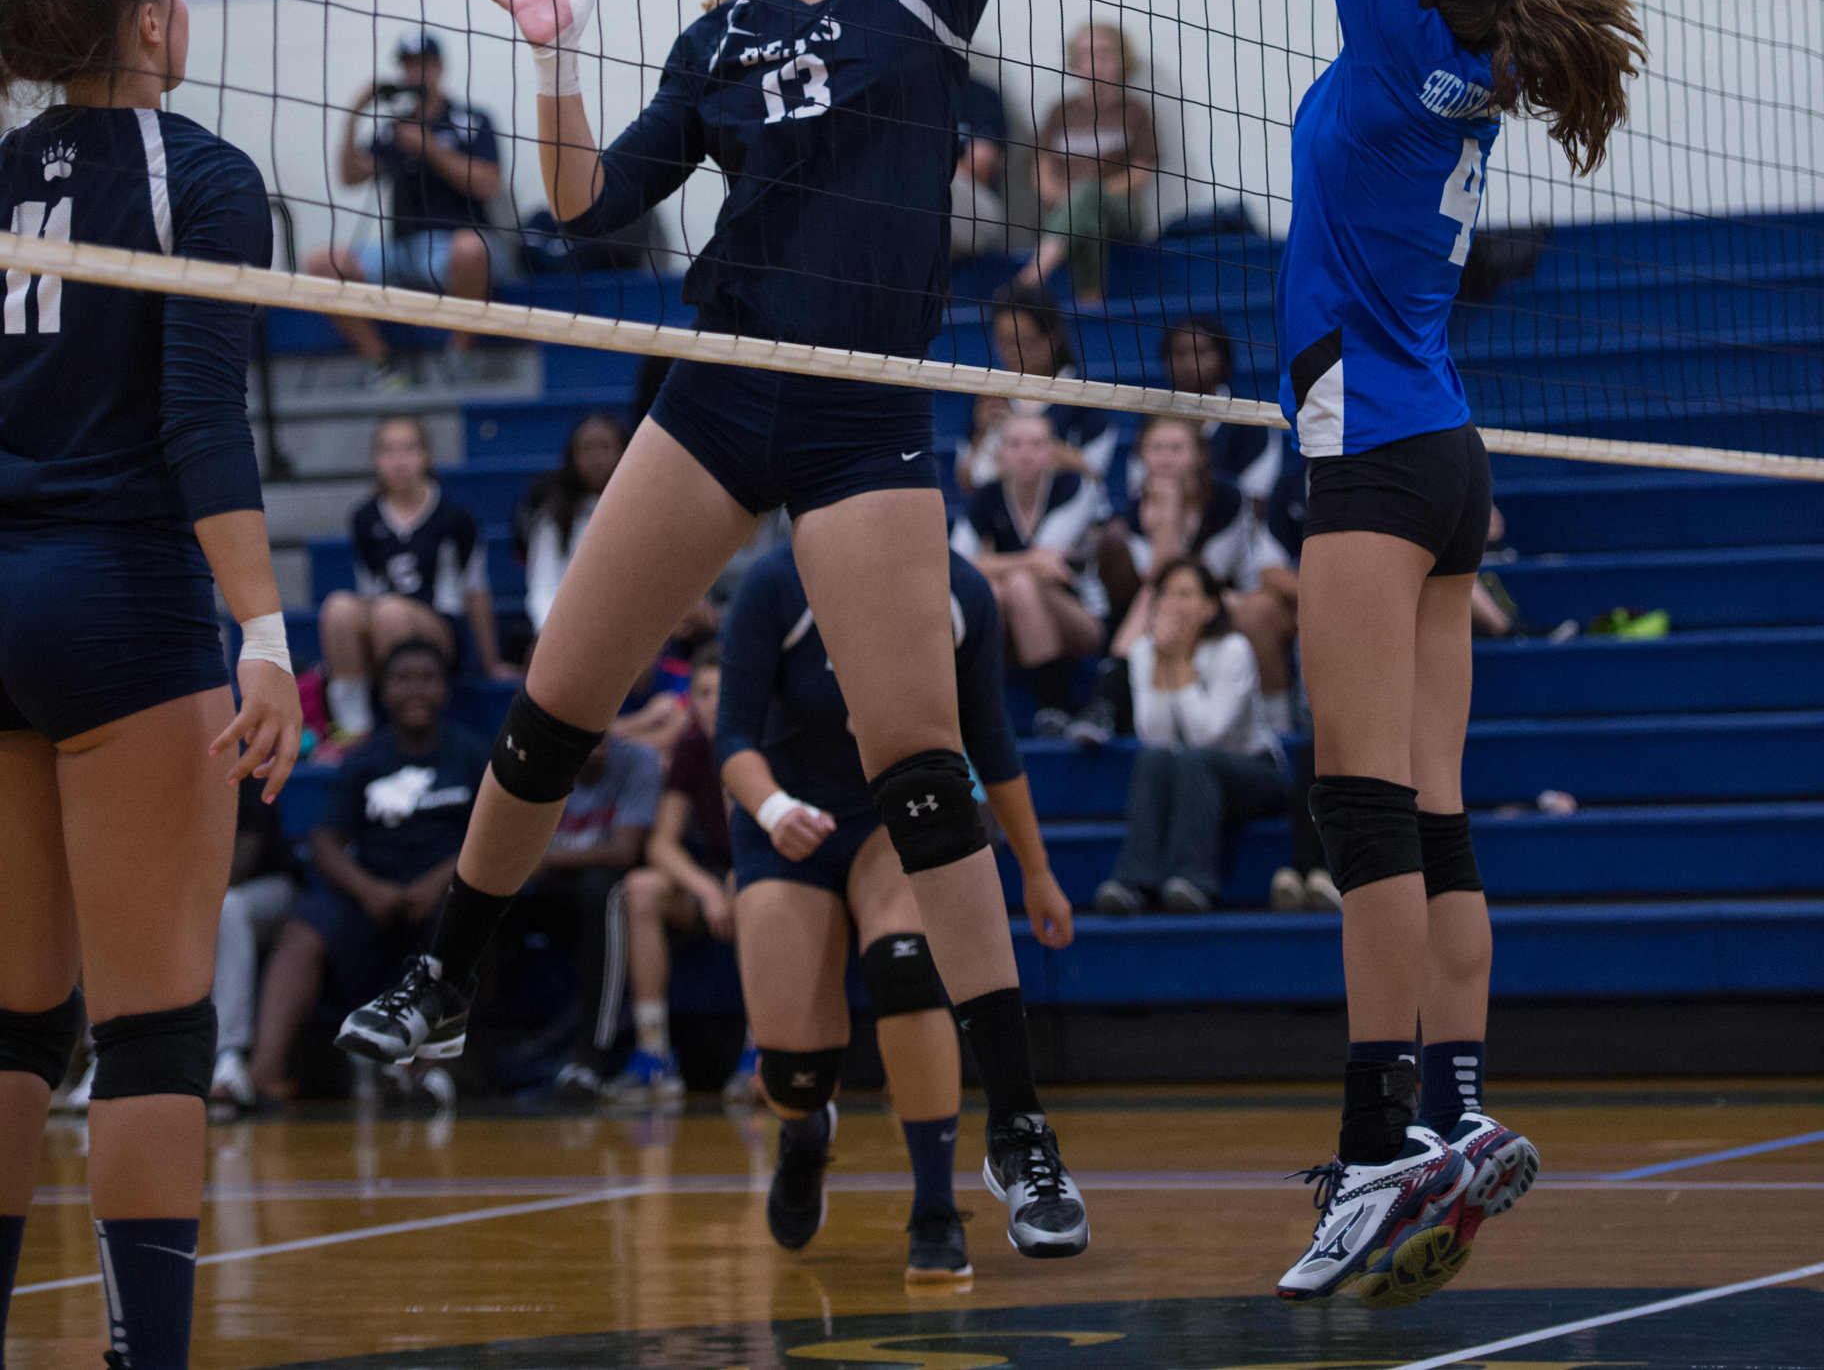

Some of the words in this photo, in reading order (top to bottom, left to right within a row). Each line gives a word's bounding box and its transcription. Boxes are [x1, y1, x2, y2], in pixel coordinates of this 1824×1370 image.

[739, 15, 842, 67] BEAS
[761, 53, 831, 125] 13
[1439, 138, 1482, 267] 4
[4, 196, 73, 334] 11
